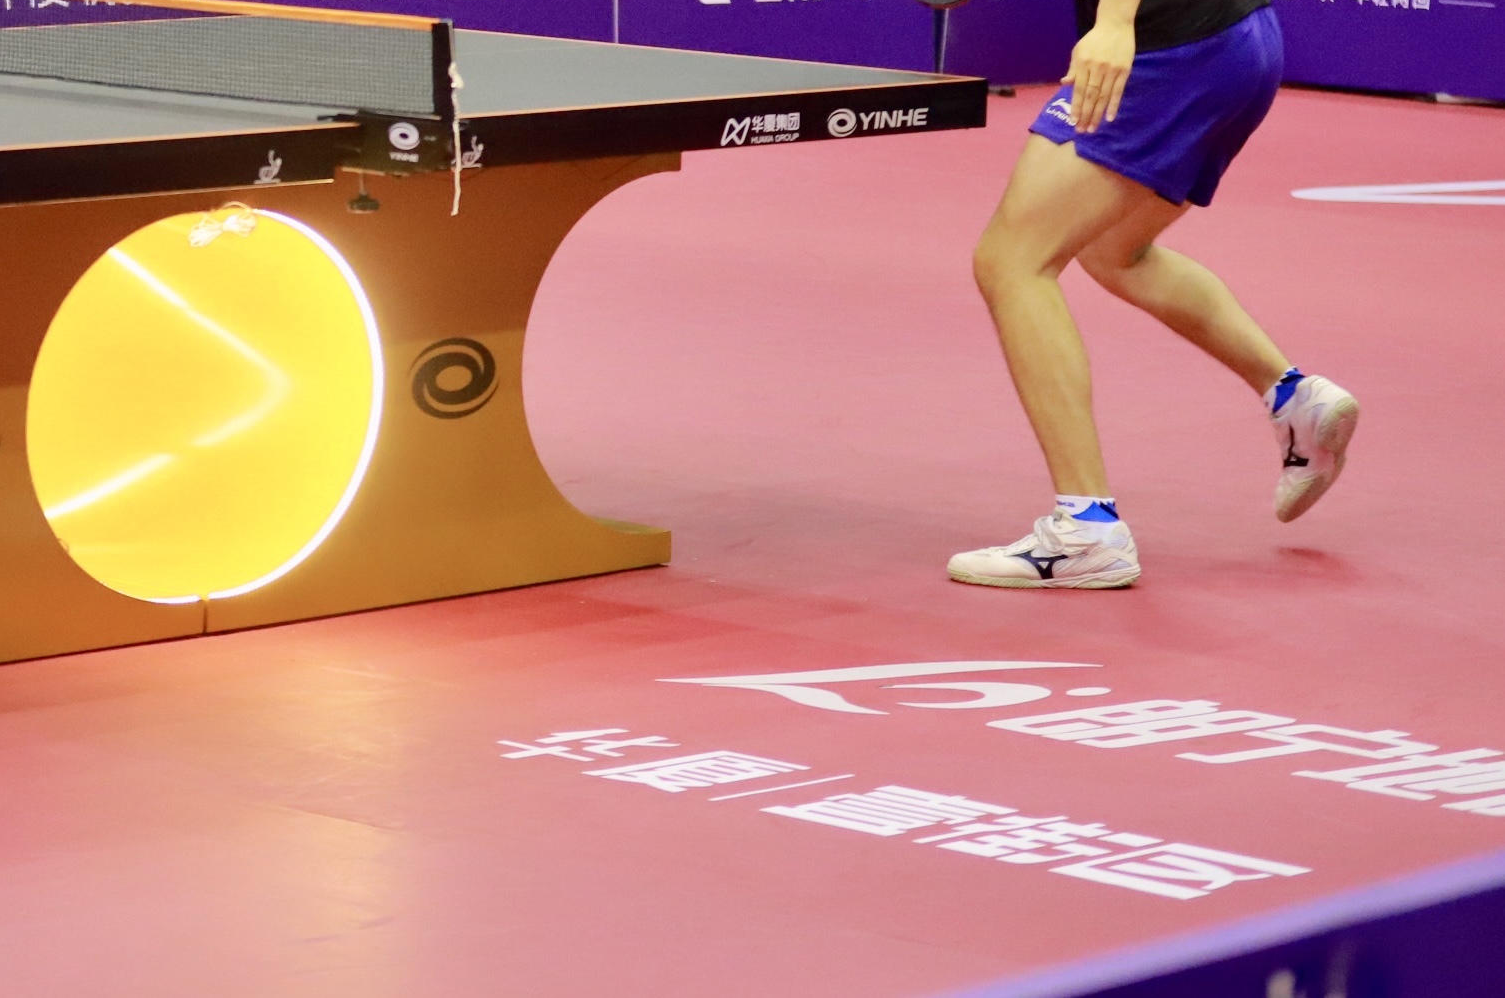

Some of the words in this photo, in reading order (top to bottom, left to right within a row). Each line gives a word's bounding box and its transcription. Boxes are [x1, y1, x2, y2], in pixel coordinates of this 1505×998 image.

[751, 112, 800, 133] 华夏集团
[860, 107, 929, 131] YINHE
[985, 699, 1505, 817] 朗宁地
[496, 727, 813, 794] 华夏
[757, 784, 1314, 901] 壹街区
